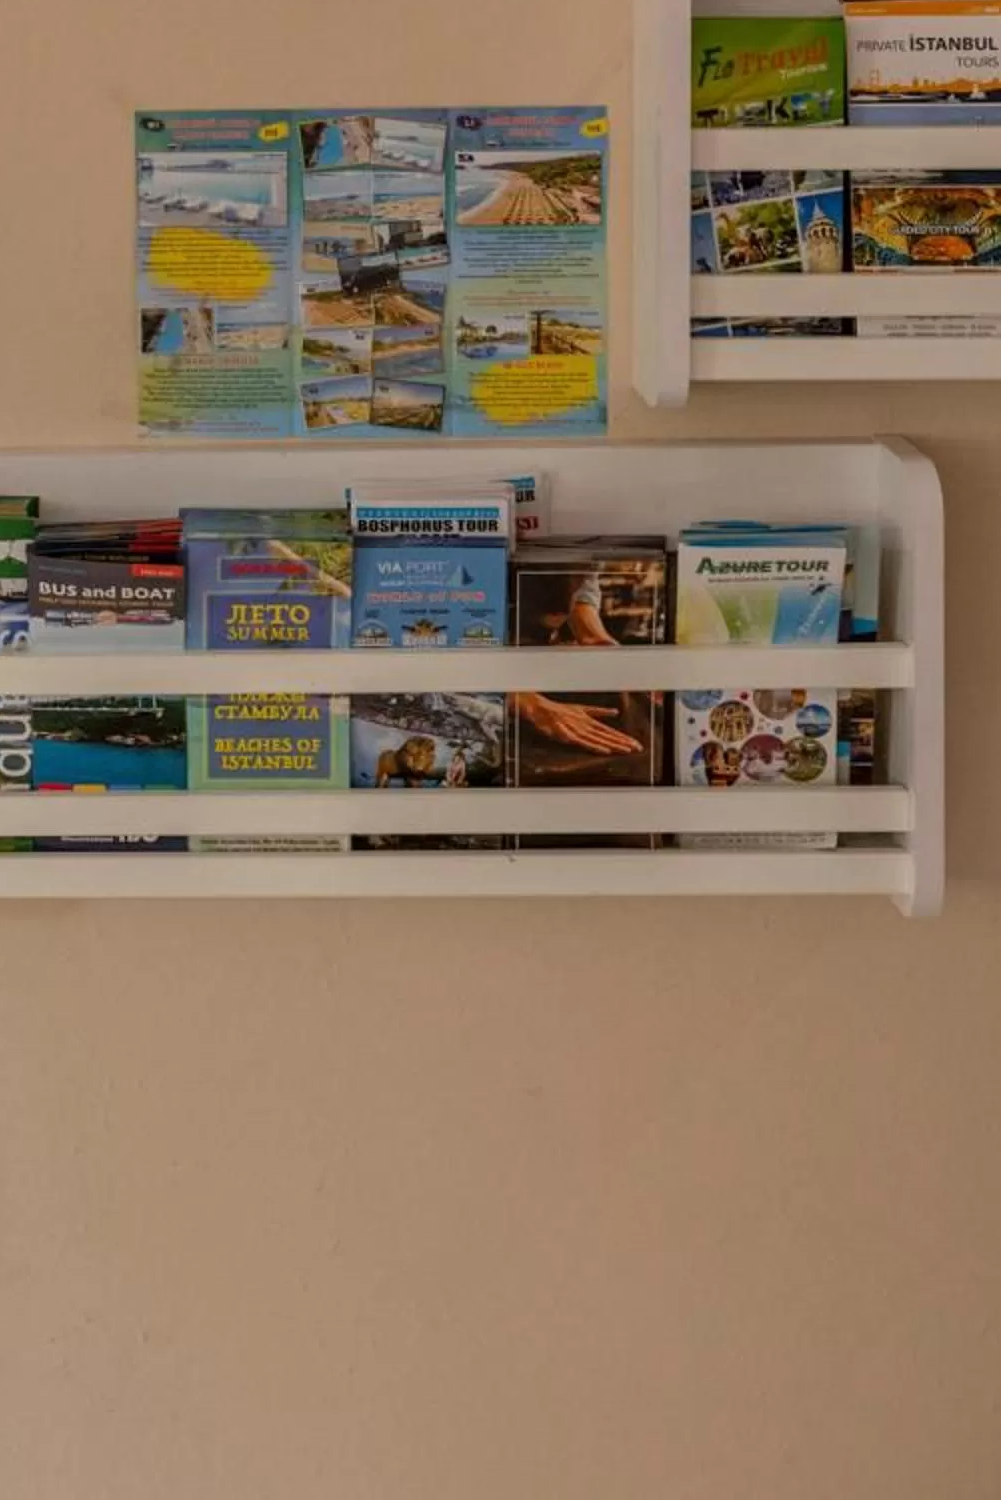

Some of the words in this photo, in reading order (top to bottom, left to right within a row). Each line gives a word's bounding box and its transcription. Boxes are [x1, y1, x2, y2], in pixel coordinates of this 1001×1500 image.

[357, 519, 453, 533] BOSPHORUS
[456, 519, 499, 532] TOUR
[377, 561, 403, 574] VIA
[38, 581, 78, 597] BUS
[82, 586, 116, 599] and
[121, 587, 176, 600] BOAT
[226, 603, 311, 625] ЛЕТО
[226, 625, 311, 641] SUMMER
[214, 738, 292, 753] BEACHES
[296, 738, 321, 753] OF
[221, 754, 317, 770] ISTANBUL
